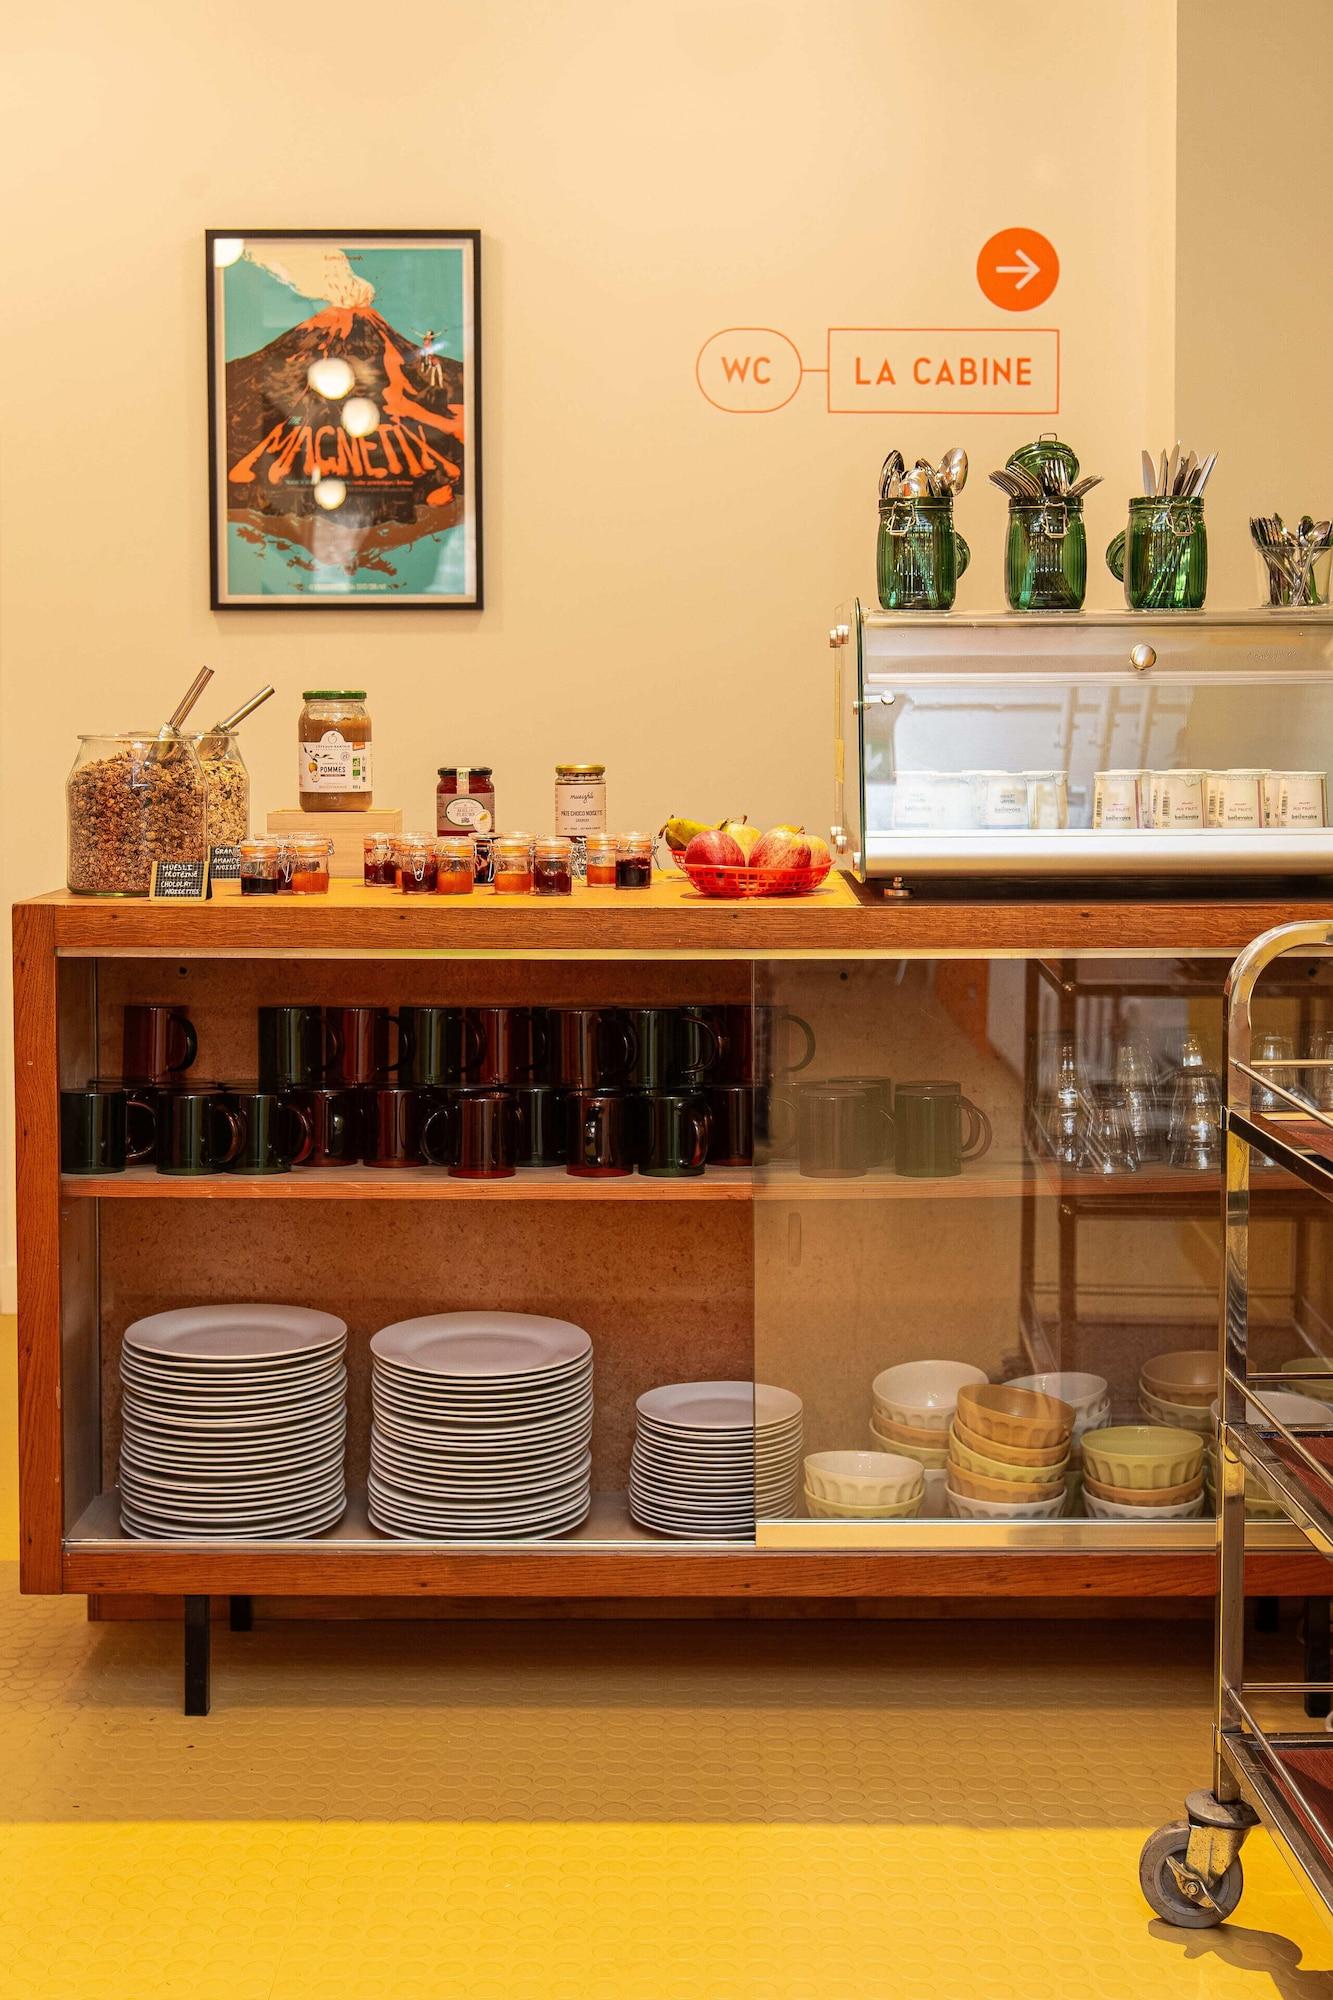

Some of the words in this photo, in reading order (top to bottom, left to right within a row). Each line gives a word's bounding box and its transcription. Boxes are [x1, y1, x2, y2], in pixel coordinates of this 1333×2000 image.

[721, 356, 771, 384] WC
[855, 357, 897, 385] LA
[913, 357, 1032, 386] CABINE
[160, 880, 192, 888] CHOCOLAT
